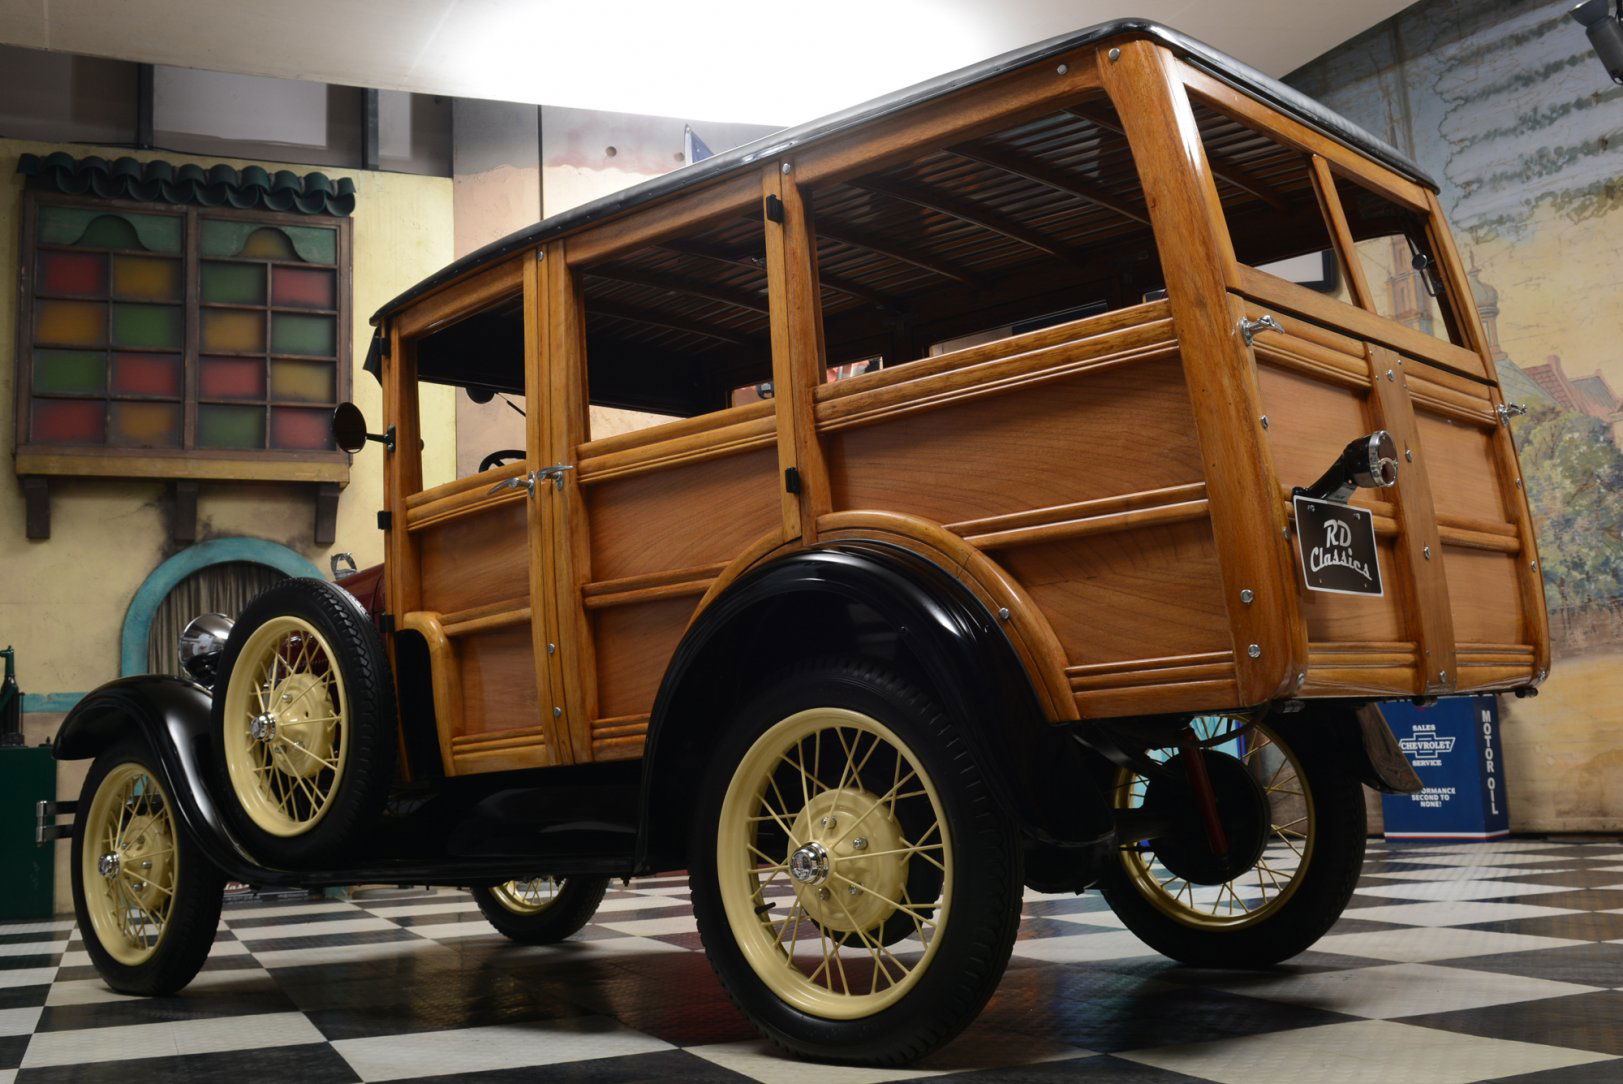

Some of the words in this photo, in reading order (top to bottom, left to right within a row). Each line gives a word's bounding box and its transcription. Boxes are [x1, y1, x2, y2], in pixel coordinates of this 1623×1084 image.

[1324, 519, 1352, 548] RD
[1310, 546, 1373, 581] Classics
[1400, 741, 1451, 750] CHEVROLET
[1482, 710, 1494, 773] MOTOR
[1487, 777, 1499, 815] OIL
